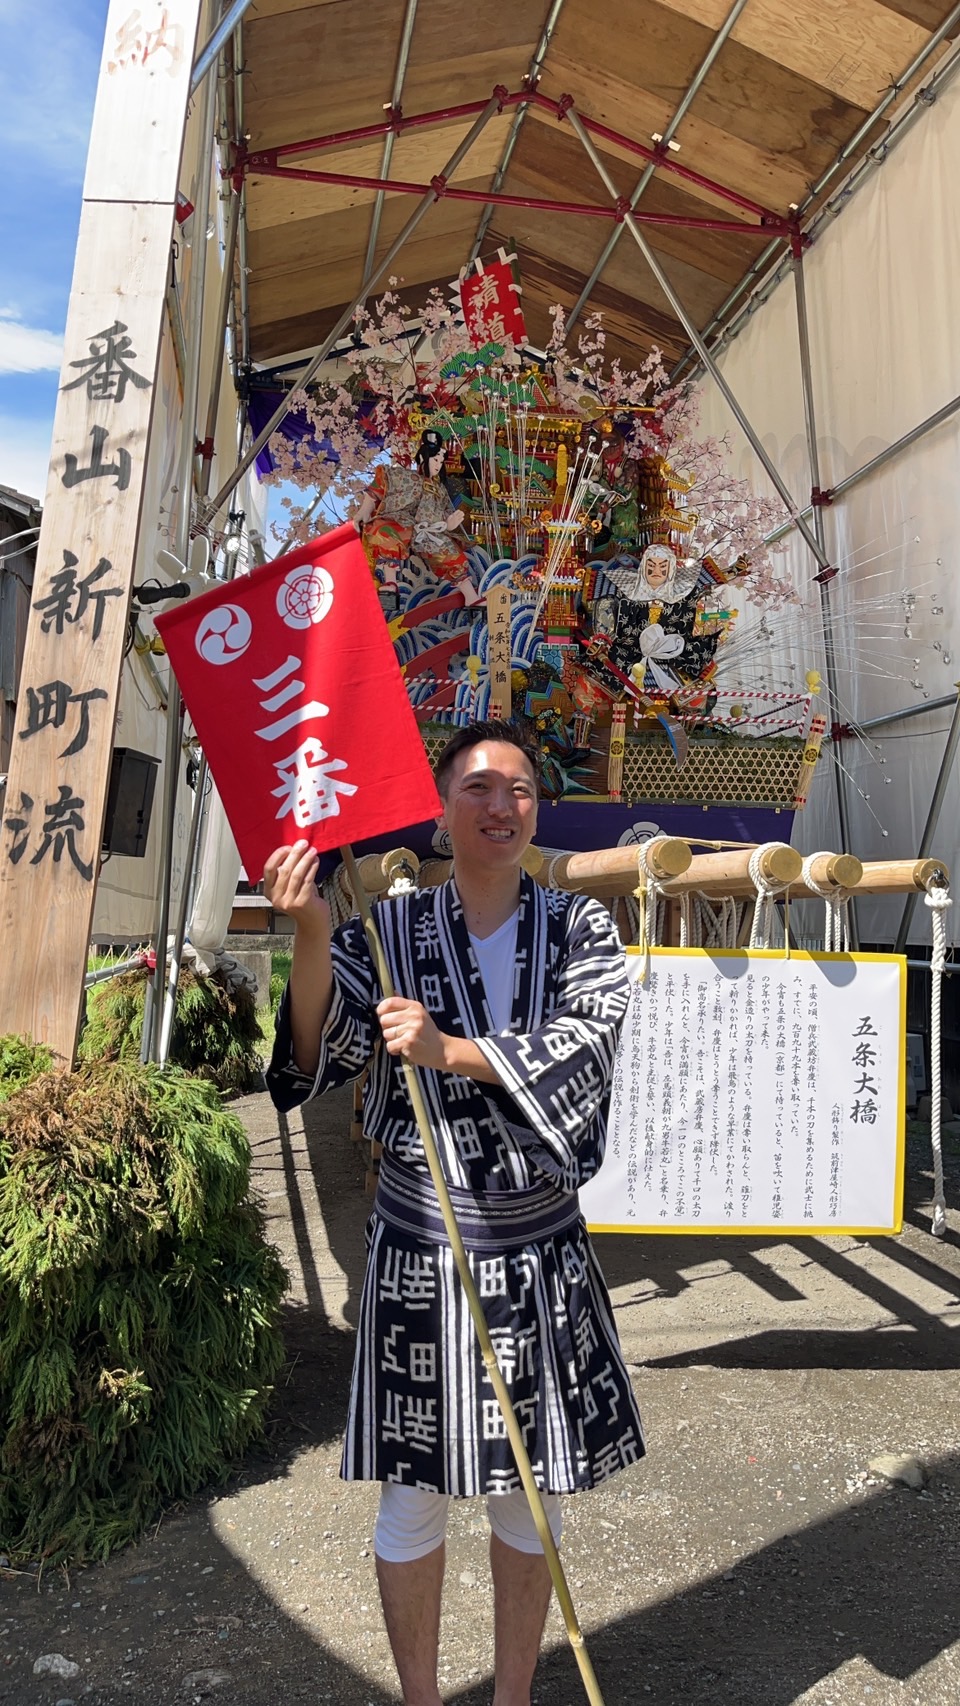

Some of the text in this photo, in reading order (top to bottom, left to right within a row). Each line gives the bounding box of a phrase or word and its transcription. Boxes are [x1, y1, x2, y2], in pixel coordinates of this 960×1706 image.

[494, 612, 507, 684] 五条大橋
[252, 655, 358, 829] 三番
[761, 975, 770, 1050] の少年がやって来た。
[850, 1016, 878, 1126] 五条大橋
